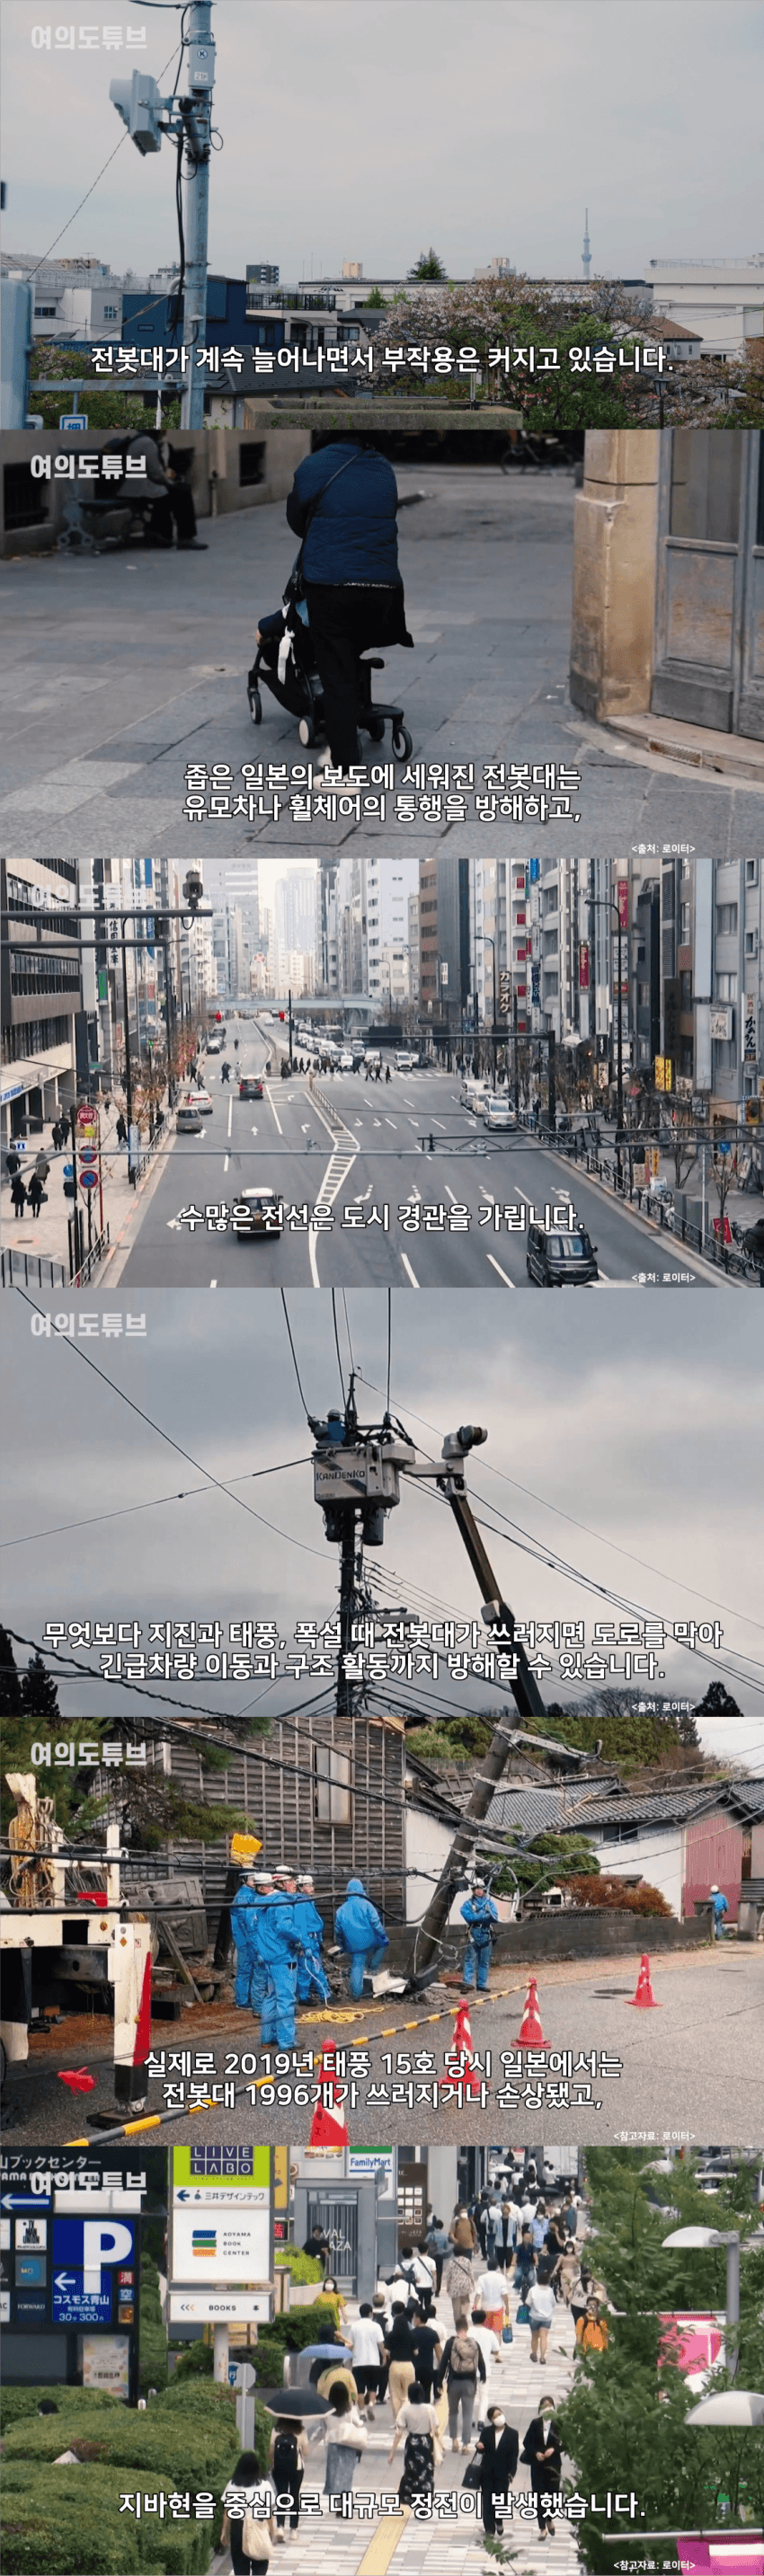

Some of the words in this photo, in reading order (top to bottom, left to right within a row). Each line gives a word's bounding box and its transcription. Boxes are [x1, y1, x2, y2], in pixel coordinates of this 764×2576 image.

[500, 971, 511, 1013] カラオケ
[194, 2147, 250, 2157] LIVE
[194, 2163, 251, 2173] LABO
[351, 2158, 390, 2168] FamilyMart
[0, 2172, 27, 2181] AMA
[205, 2192, 264, 2200] 三井デザインテック
[23, 2235, 40, 2244] UNION
[84, 2221, 133, 2294] P
[120, 2288, 132, 2300] 空
[53, 2295, 110, 2305] コスモス青山
